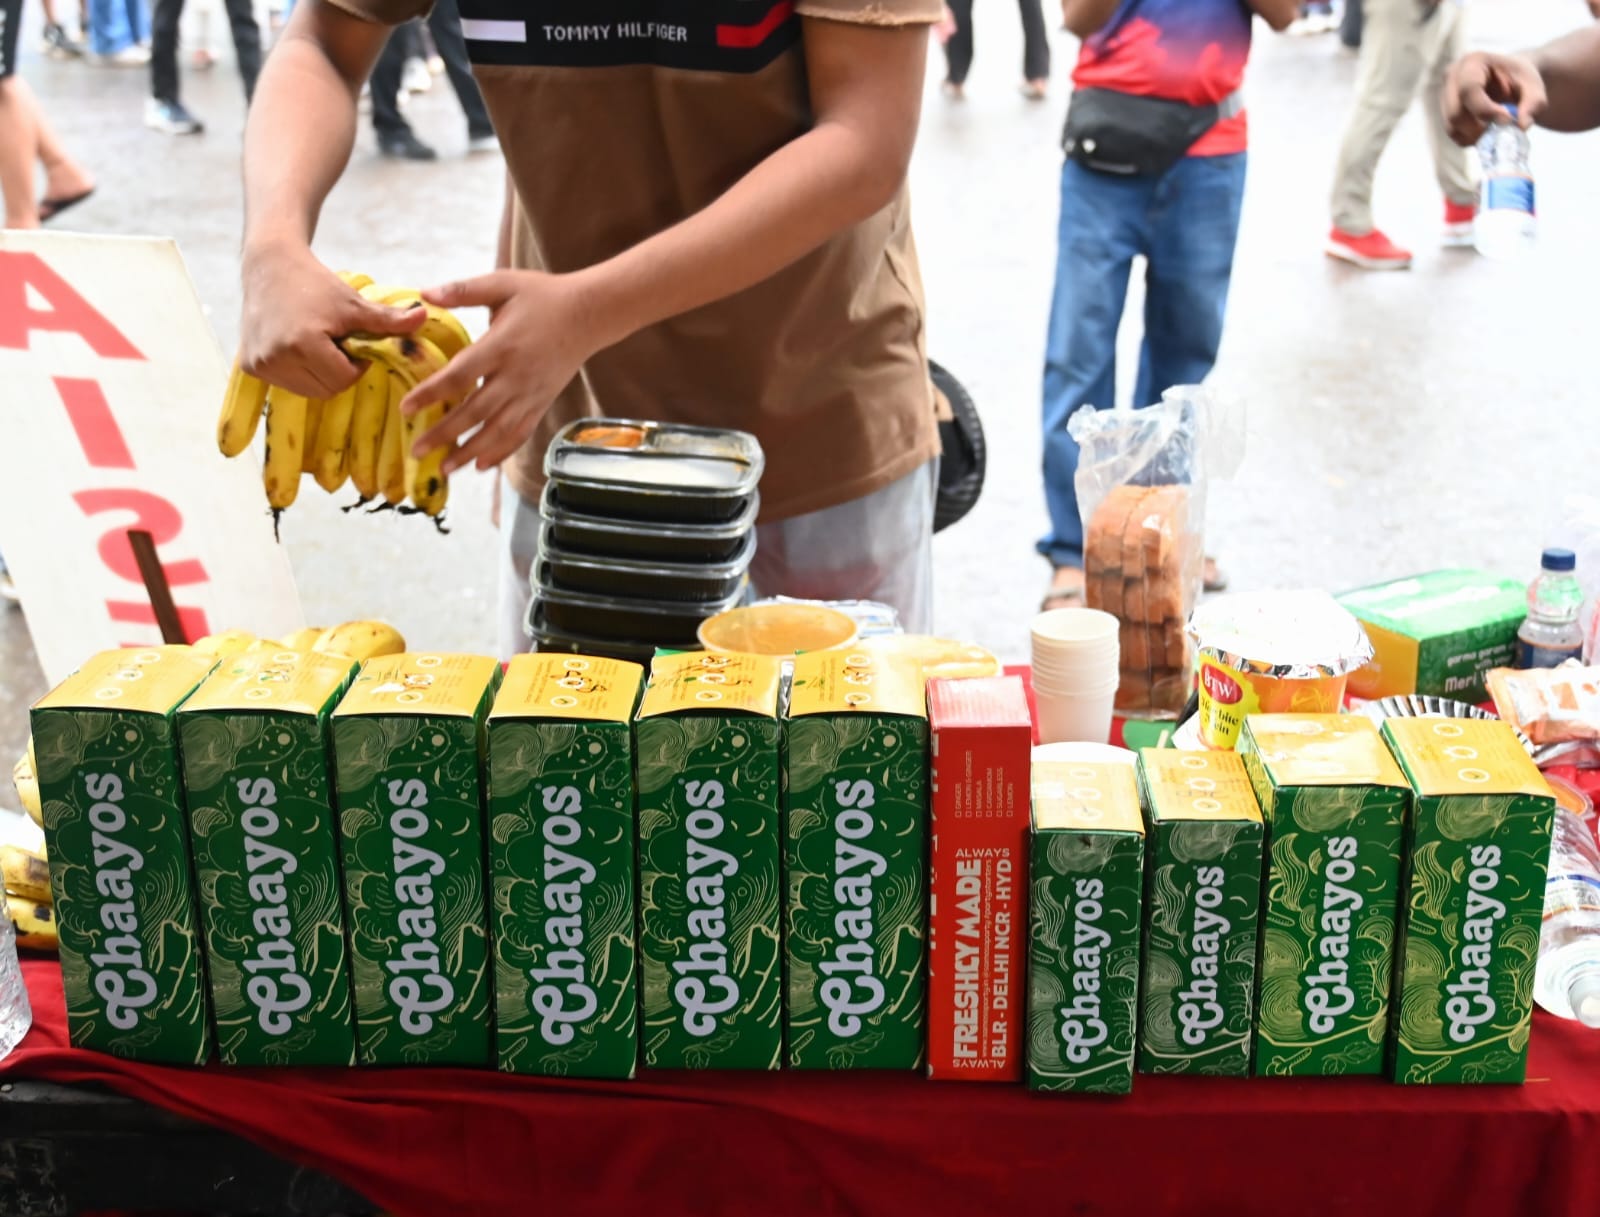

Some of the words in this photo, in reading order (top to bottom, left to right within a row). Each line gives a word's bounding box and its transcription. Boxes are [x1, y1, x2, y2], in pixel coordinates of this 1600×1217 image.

[543, 24, 611, 41] TOMMY
[617, 23, 688, 42] HILFIGER
[1204, 665, 1234, 699] BTW
[88, 773, 157, 1029] Chaayos
[239, 779, 311, 1035] Chaayos
[388, 779, 454, 1035] Chaayos
[531, 786, 598, 1045] Chaayos
[673, 780, 740, 1036] Chaayos
[820, 780, 887, 1037] Chaayos
[954, 859, 982, 938] MADE
[955, 848, 1009, 858] ALWAYS
[995, 859, 1012, 900] HYD
[995, 912, 1010, 950] NCR
[1304, 836, 1362, 1033] Chaayos
[993, 953, 1009, 1011] DELHI
[1061, 878, 1110, 1063] Chaayos
[1179, 866, 1230, 1045] Chaayos
[1443, 845, 1505, 1043] Chaayos
[952, 1059, 1006, 1069] ALWAYS
[991, 1021, 1007, 1058] BLR
